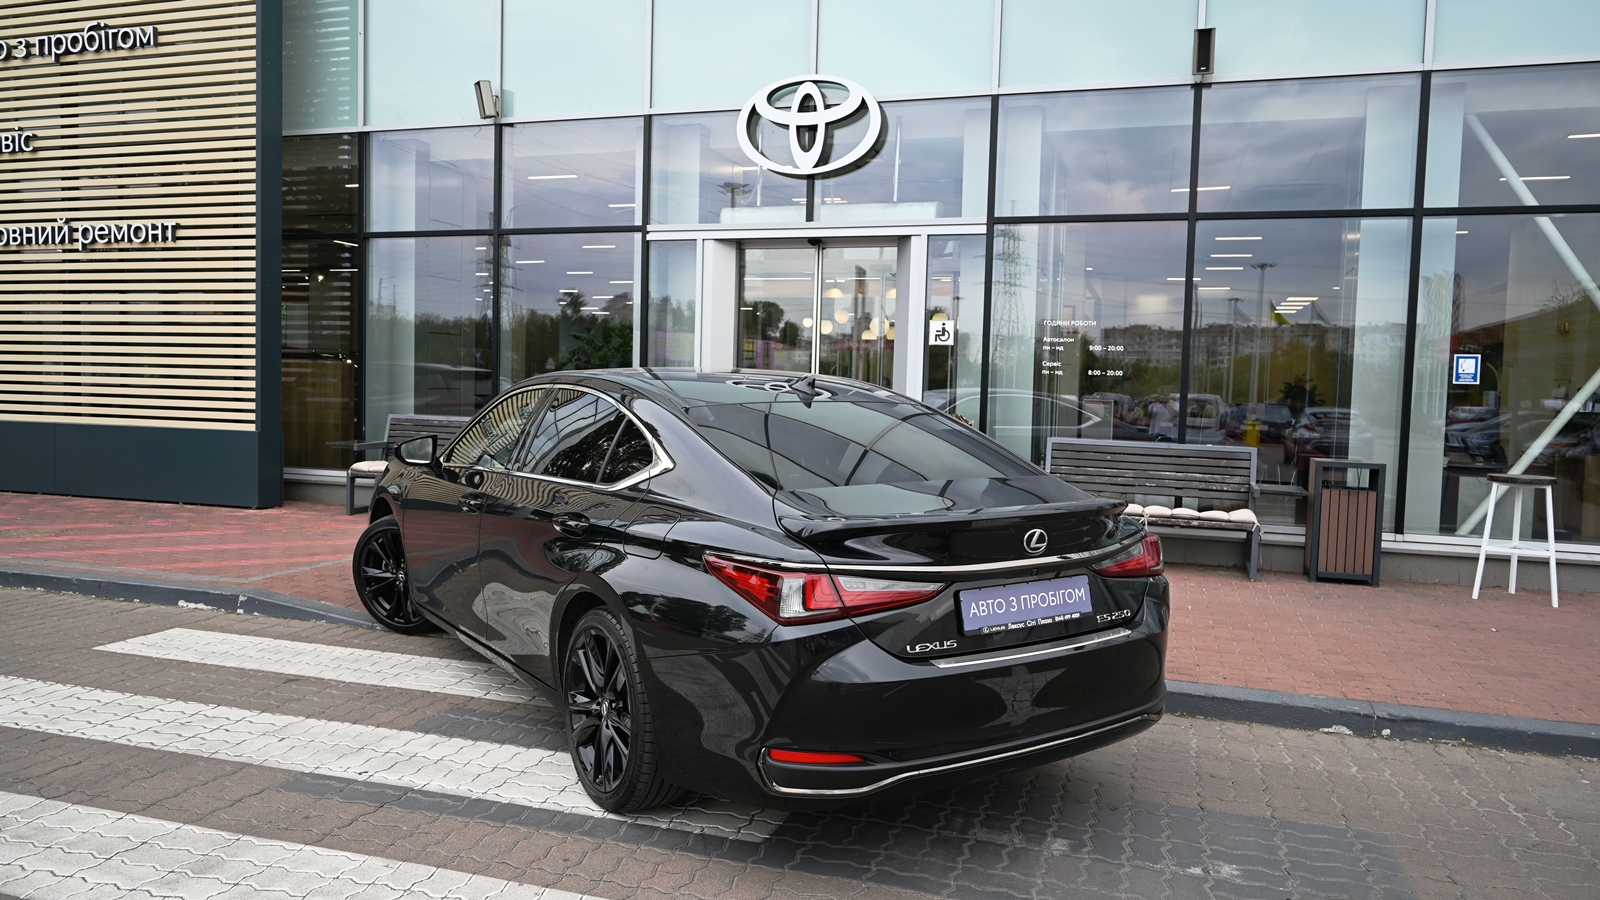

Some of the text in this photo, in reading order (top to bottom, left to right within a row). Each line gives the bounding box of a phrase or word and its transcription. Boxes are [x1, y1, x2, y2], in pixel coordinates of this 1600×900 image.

[15, 38, 27, 58] з
[36, 22, 155, 62] пробігом
[1, 126, 34, 152] віс
[78, 222, 177, 252] ремонт
[969, 598, 1006, 618] АВТО
[1021, 587, 1086, 611] ПРОБІГОМ
[1096, 609, 1131, 624] ES 250
[906, 639, 957, 654] LEXUS
